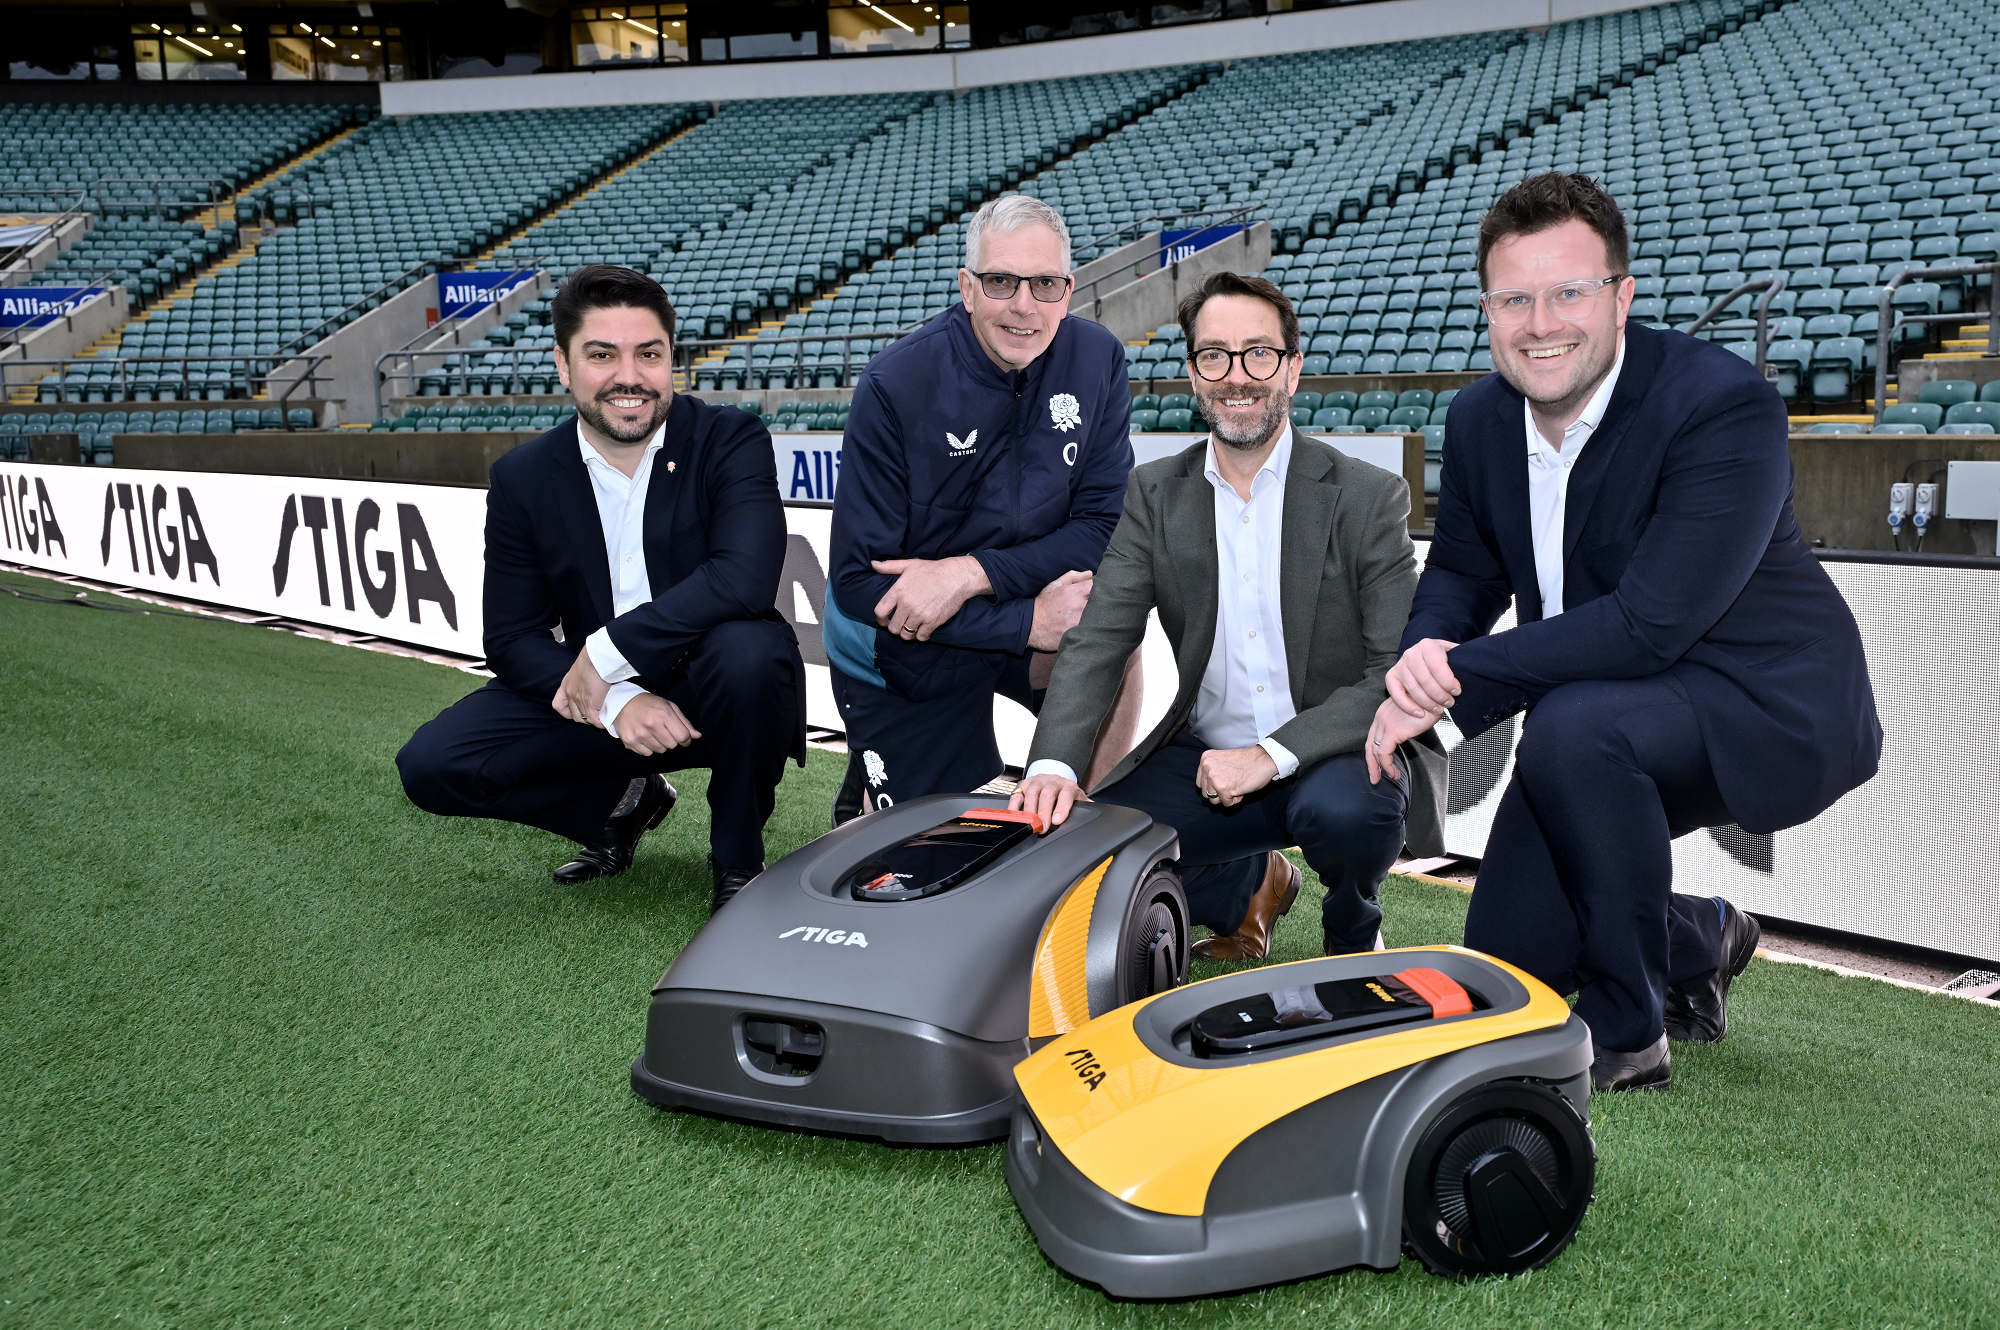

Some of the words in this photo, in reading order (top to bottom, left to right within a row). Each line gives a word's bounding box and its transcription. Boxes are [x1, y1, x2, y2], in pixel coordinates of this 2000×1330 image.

[100, 481, 221, 588] STIGA
[272, 492, 458, 632] STIGA
[778, 926, 869, 949] STIGA
[1064, 1049, 1106, 1092] STIGA
